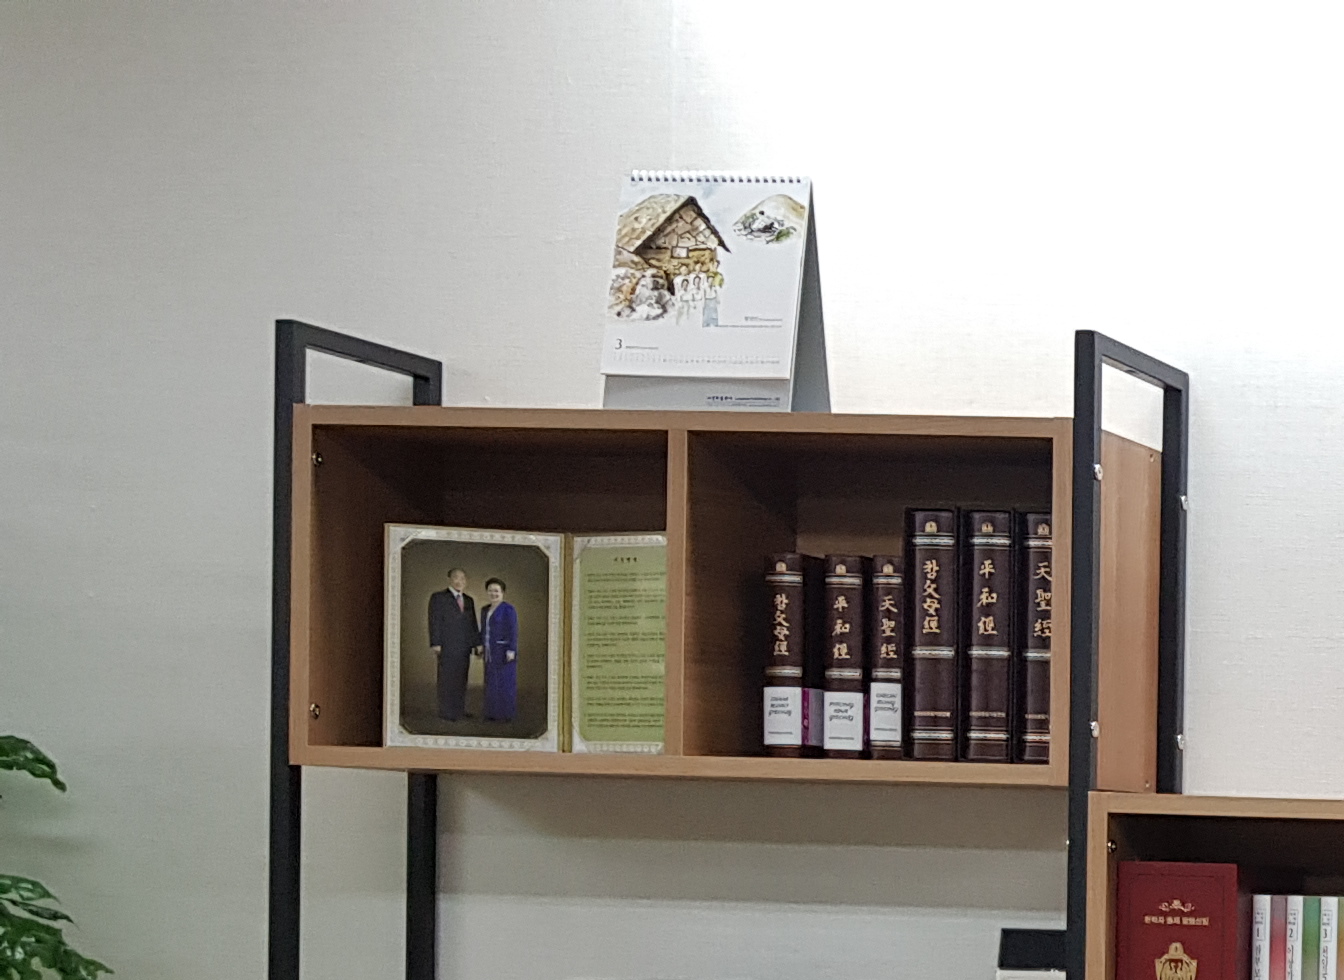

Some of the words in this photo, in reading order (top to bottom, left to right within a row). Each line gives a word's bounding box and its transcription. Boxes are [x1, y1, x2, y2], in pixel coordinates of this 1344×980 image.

[615, 339, 622, 350] 3
[1034, 562, 1052, 637] 天聖經
